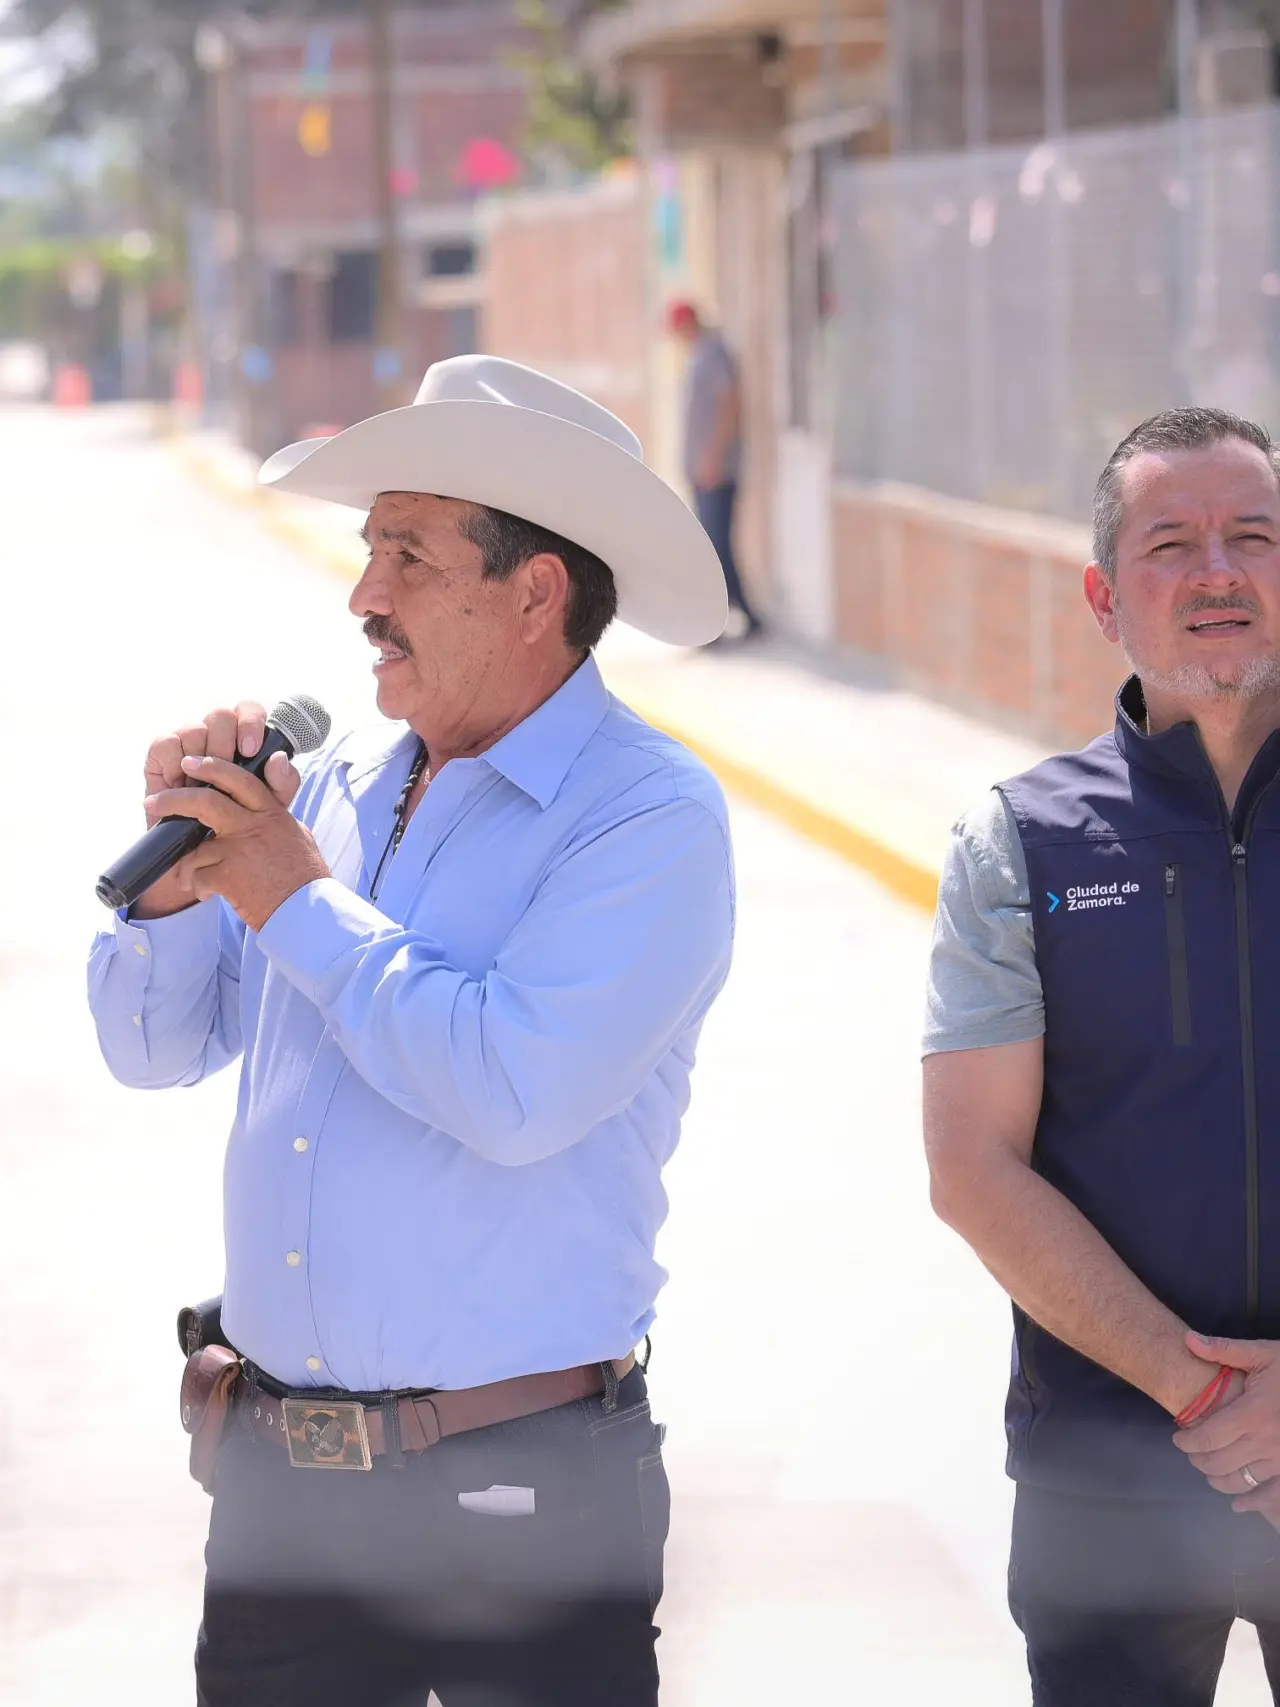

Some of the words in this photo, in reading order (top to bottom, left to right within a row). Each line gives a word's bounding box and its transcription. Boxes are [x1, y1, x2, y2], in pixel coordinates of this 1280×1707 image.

[1066, 882, 1118, 899] Ciudad
[1121, 881, 1140, 893] de
[1067, 896, 1126, 911] Zamora.
